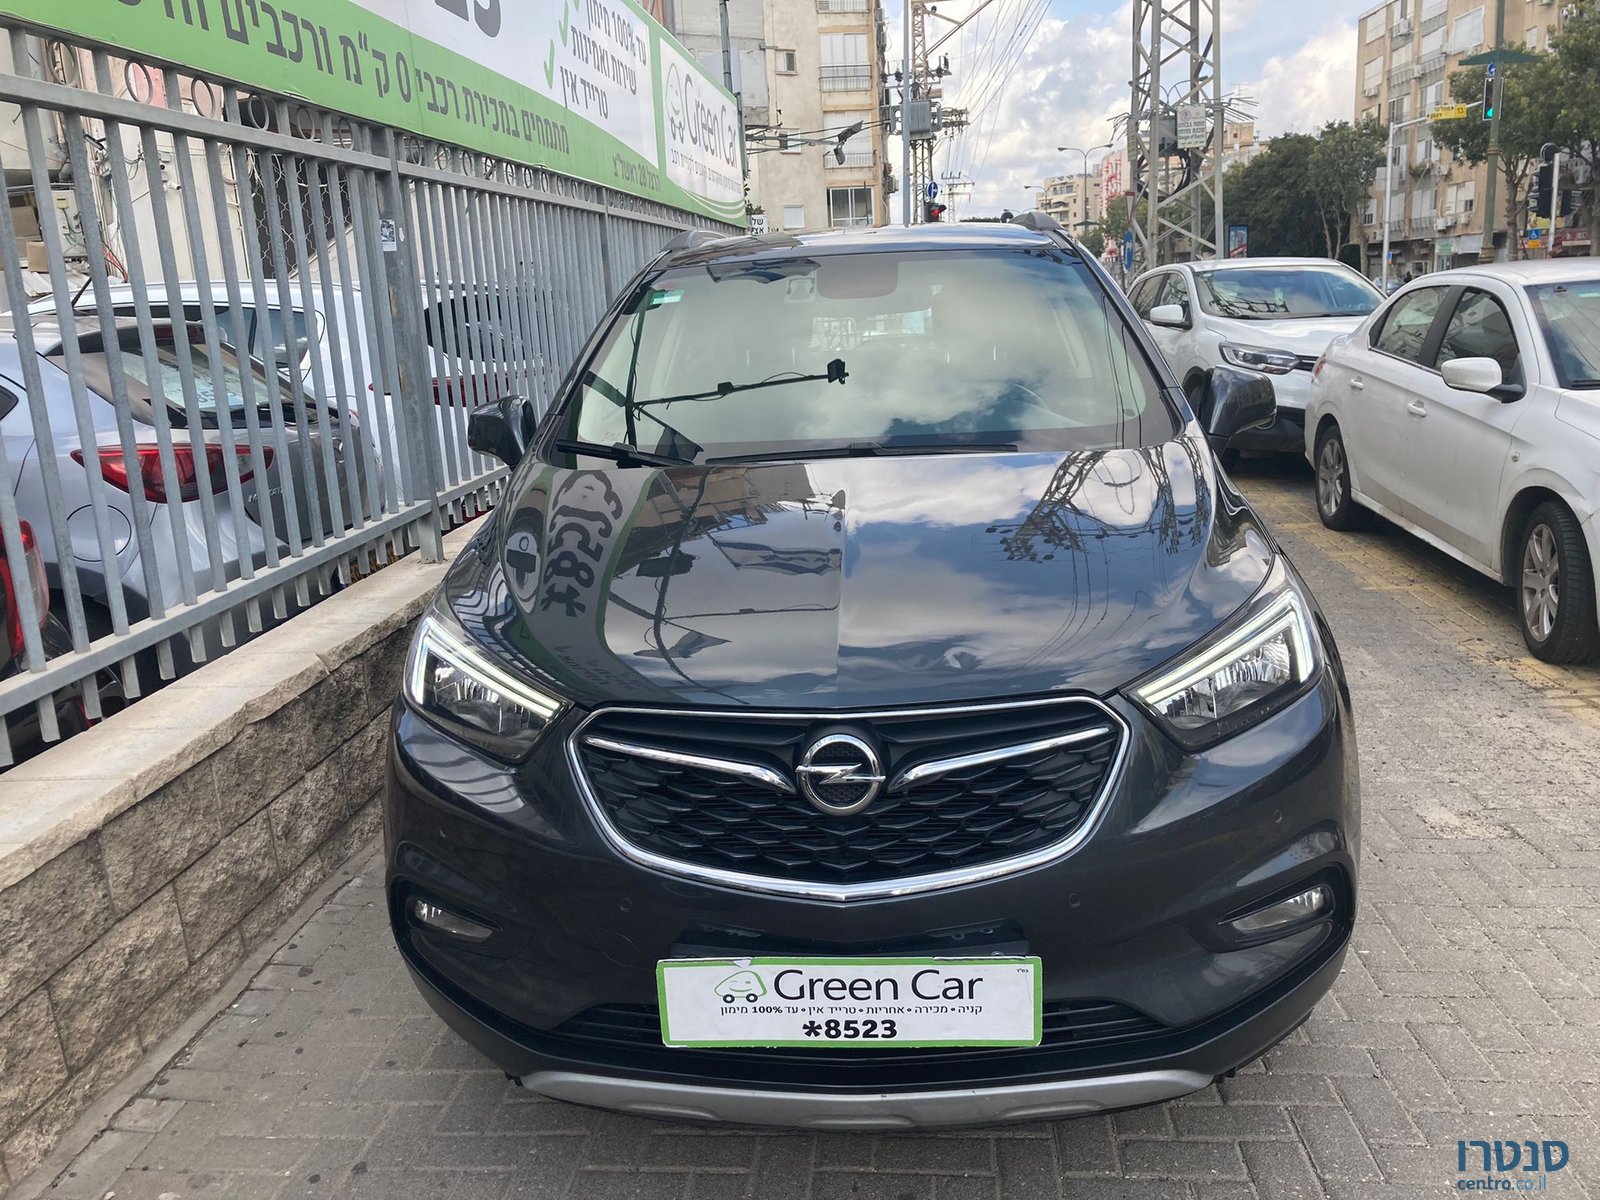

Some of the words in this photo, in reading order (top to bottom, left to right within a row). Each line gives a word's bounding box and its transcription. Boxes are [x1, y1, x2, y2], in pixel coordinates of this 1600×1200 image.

[219, 0, 334, 75] ורכבים
[586, 0, 611, 37] מימון
[612, 11, 636, 57] 100%
[571, 25, 610, 79] ואמינות
[636, 35, 647, 66] עד
[395, 51, 411, 103] 0
[415, 68, 461, 119] רכבי
[560, 66, 579, 109] אין
[611, 54, 637, 96] שירות
[462, 86, 520, 138] במכירת
[580, 78, 608, 119] טרייד
[521, 109, 570, 154] מתמחים
[685, 73, 722, 160] Green
[721, 104, 738, 169] Car
[774, 969, 899, 1001] Green
[911, 969, 983, 1000] Car
[720, 1006, 748, 1016] מימון
[752, 1006, 783, 1014] 100%
[785, 1006, 798, 1014] עד
[808, 1006, 824, 1015] אין
[866, 1006, 905, 1014] אחריות
[914, 1006, 948, 1014] מכירה
[958, 1005, 982, 1015] קניה
